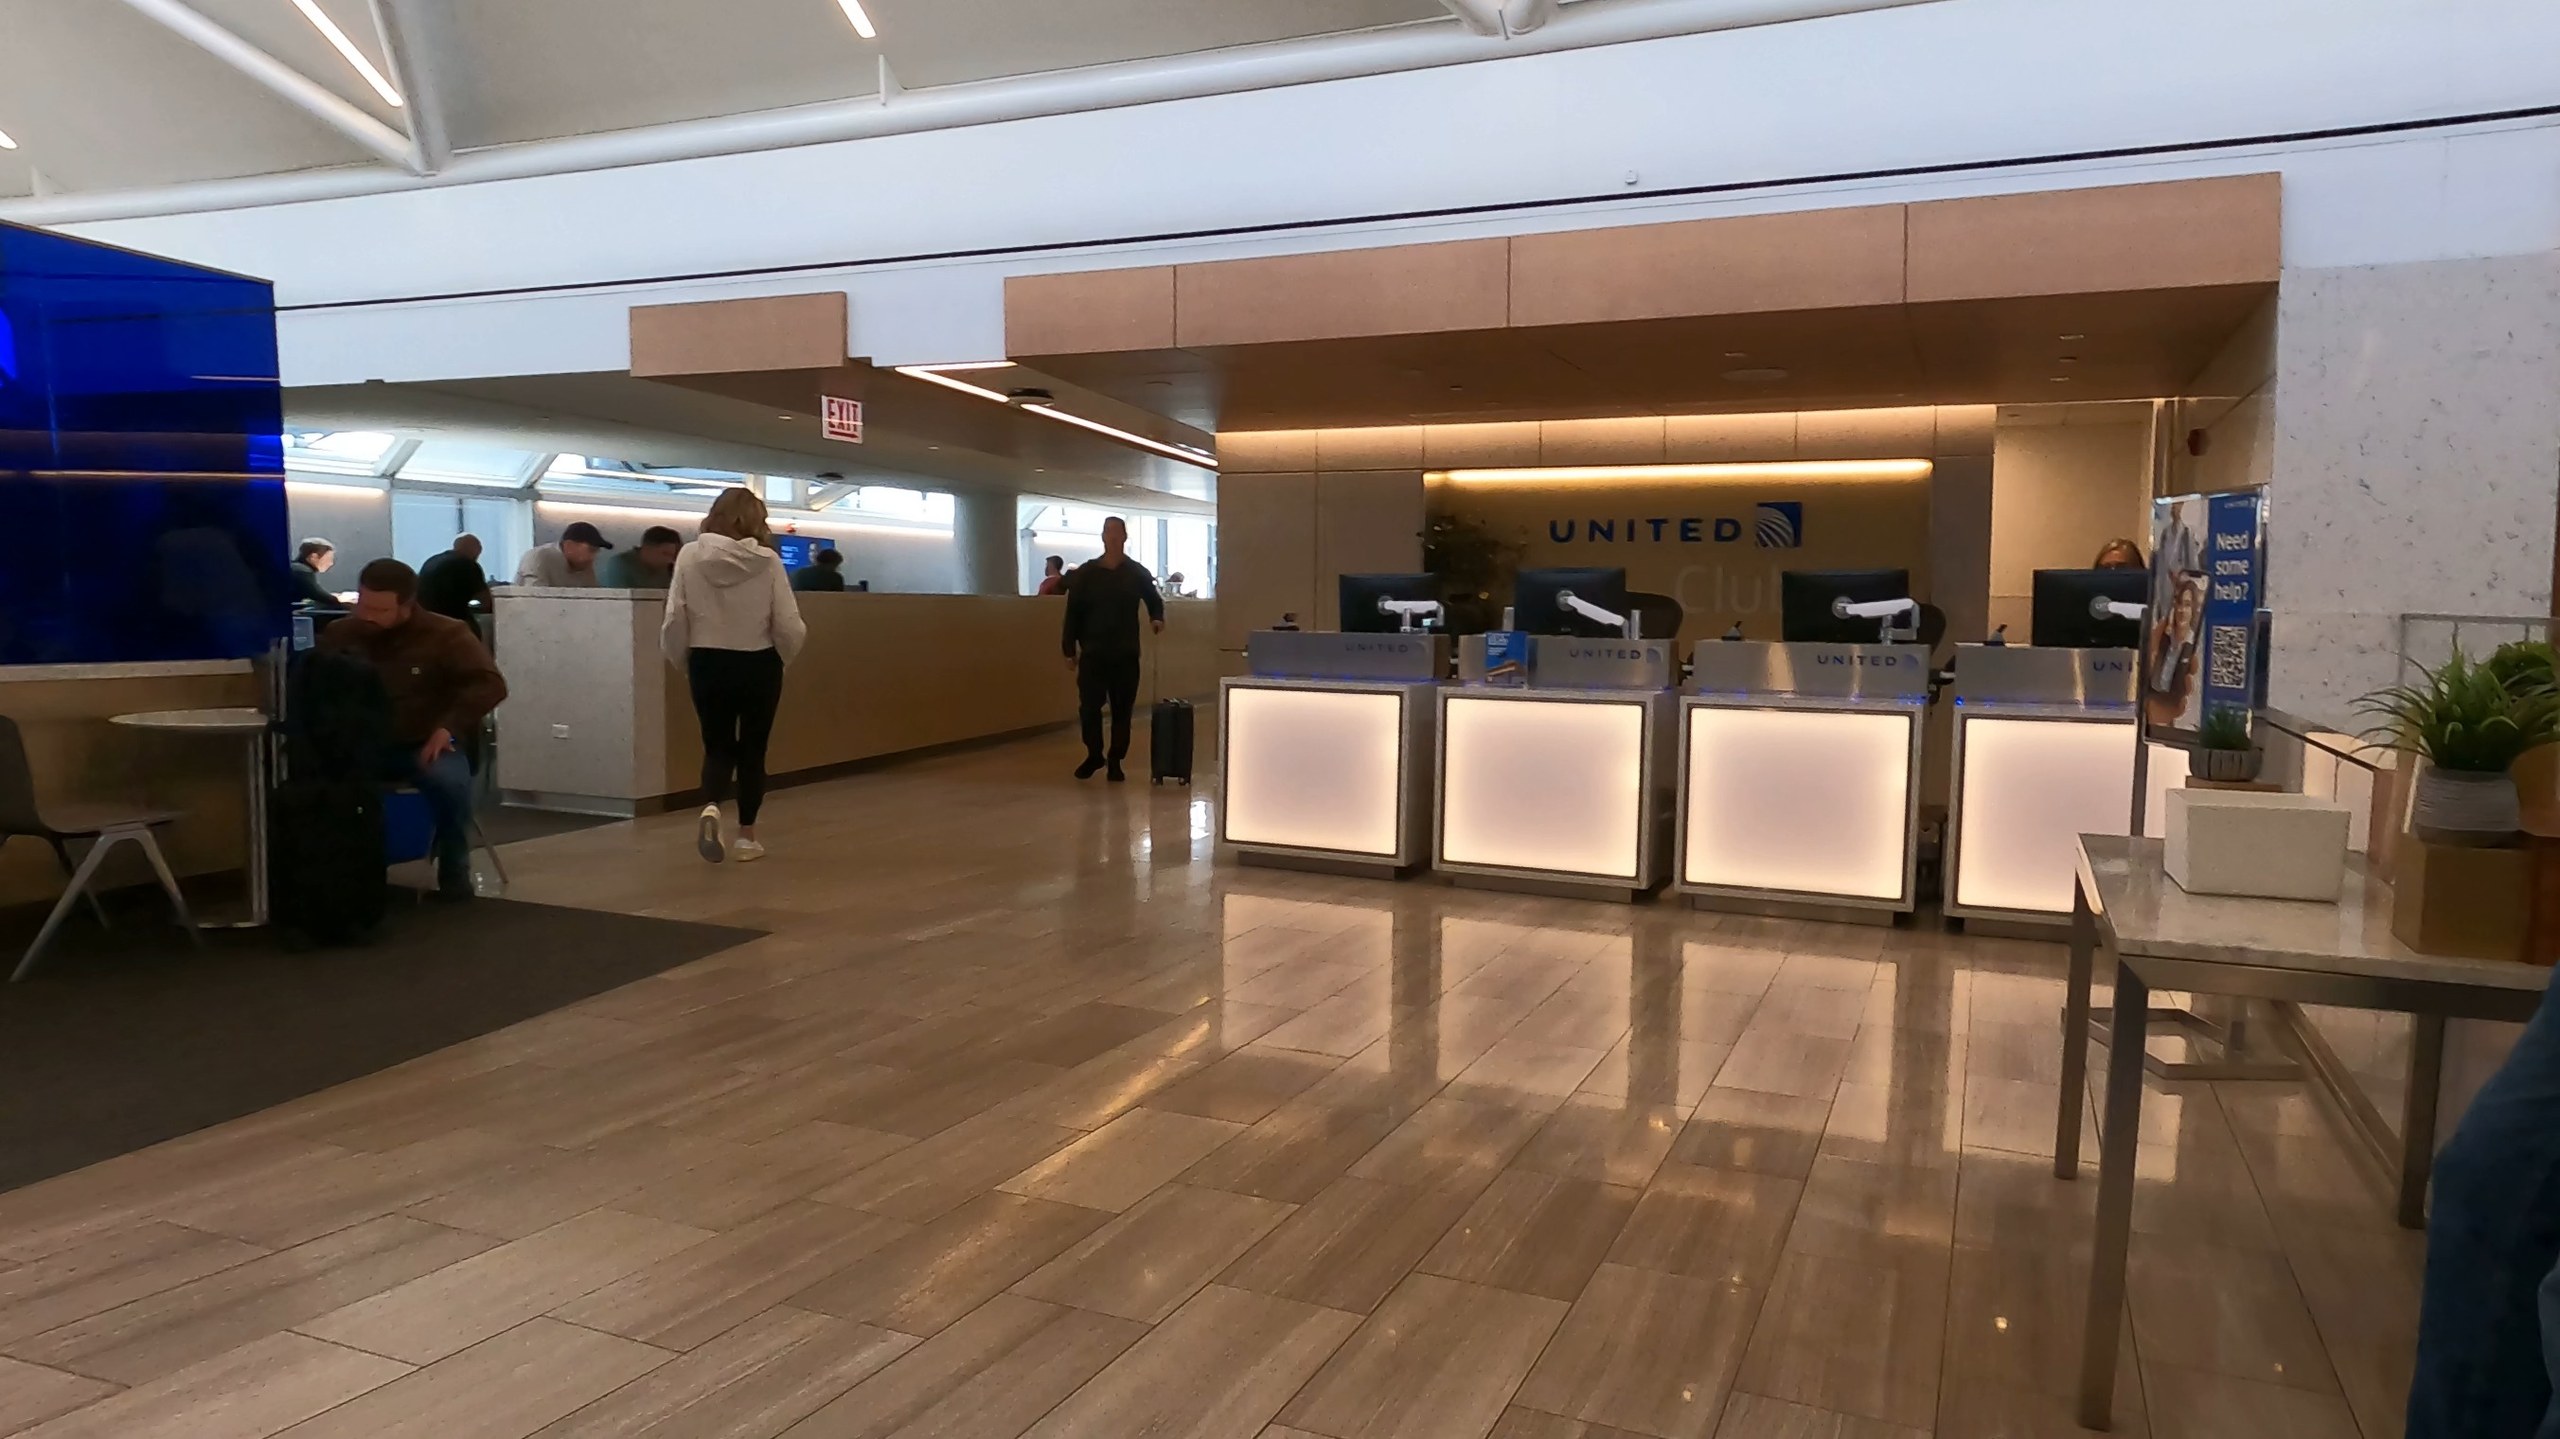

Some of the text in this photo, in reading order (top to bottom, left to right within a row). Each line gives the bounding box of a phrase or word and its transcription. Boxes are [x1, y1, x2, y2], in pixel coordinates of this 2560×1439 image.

[827, 399, 859, 432] EXIT
[1549, 518, 1742, 543] UNITED
[2215, 531, 2249, 551] Need
[2215, 559, 2249, 576] some
[2214, 581, 2249, 603] help?
[1345, 643, 1409, 653] UNITED
[1569, 648, 1641, 660] UNITED
[1817, 654, 1897, 666] UNITED
[2093, 661, 2133, 672] UNI
